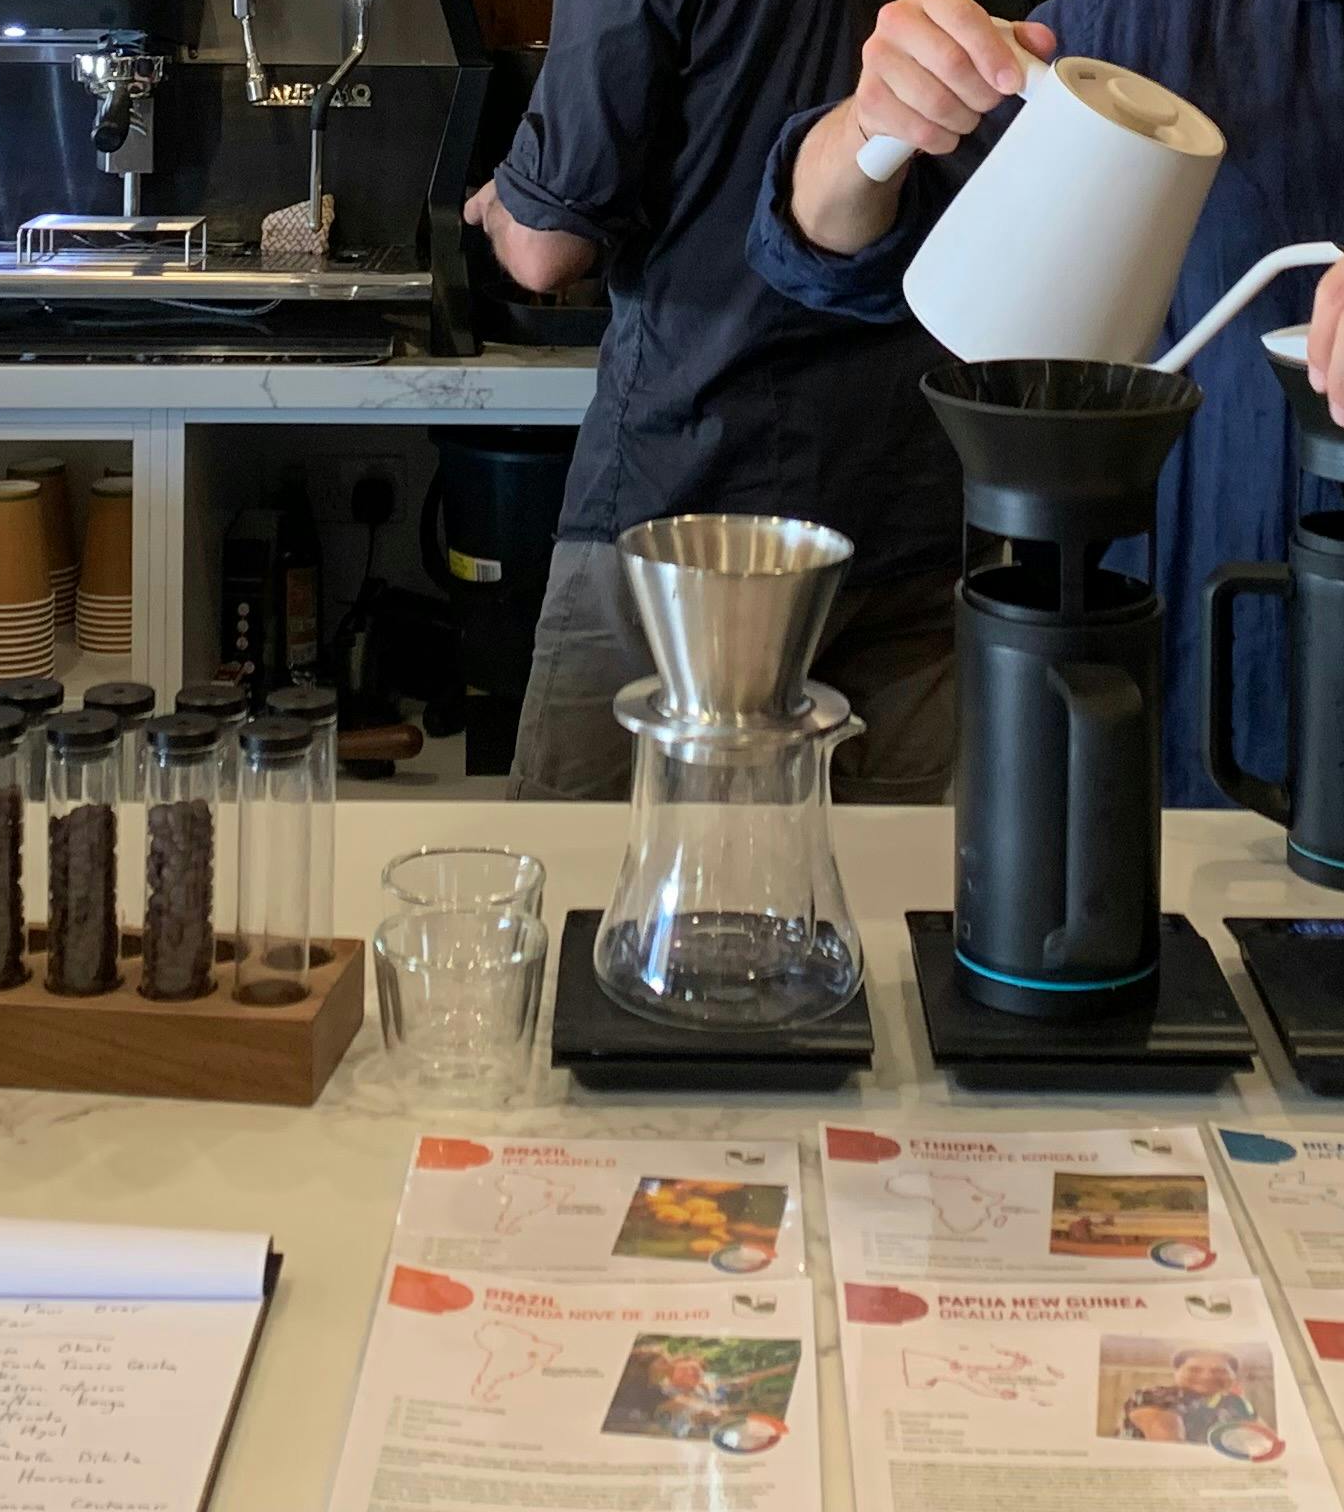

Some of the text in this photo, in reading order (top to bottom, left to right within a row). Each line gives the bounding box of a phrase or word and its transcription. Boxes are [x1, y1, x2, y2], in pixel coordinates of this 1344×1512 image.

[503, 1146, 569, 1157] BRAZIL
[909, 1140, 998, 1153] ETHIOPIA
[485, 1288, 560, 1308] BRAZIL
[938, 1295, 1148, 1309] PAPUA NEW GUINEA
